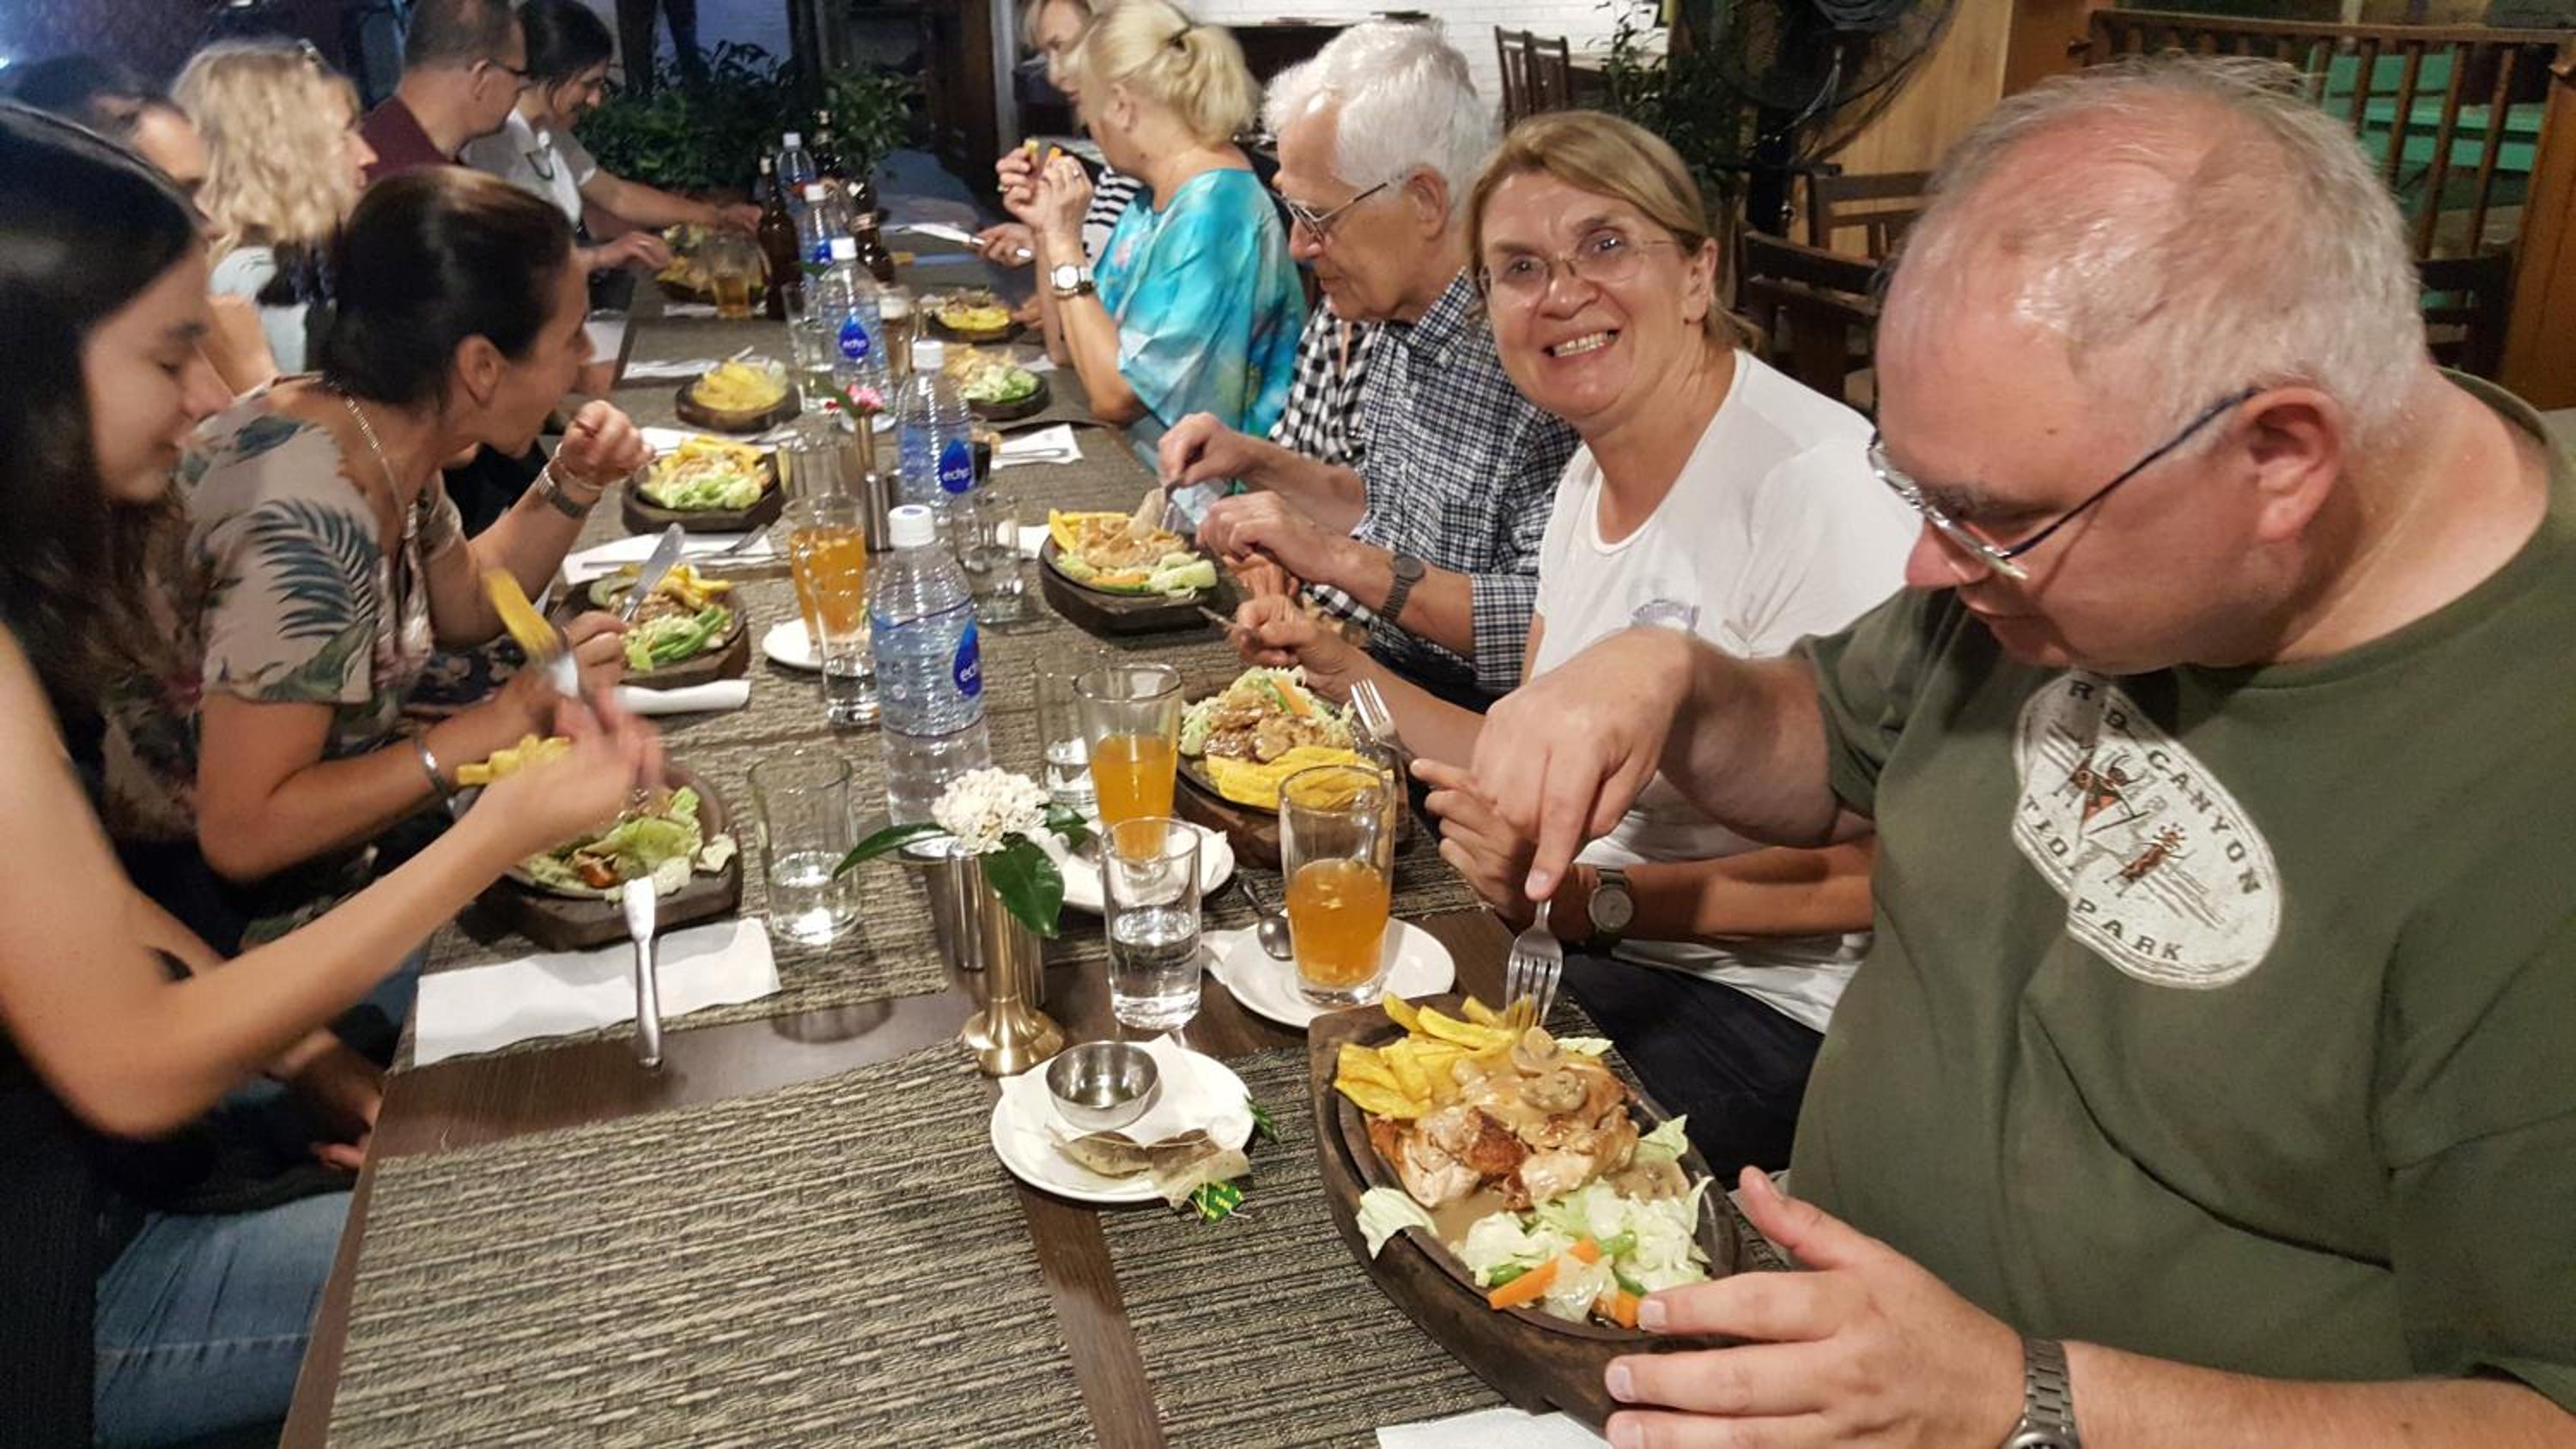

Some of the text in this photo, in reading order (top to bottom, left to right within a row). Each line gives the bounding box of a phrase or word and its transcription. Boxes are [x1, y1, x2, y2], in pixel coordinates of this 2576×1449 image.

[2069, 680, 2262, 894] RD CANYON
[2075, 897, 2183, 961] PARK
